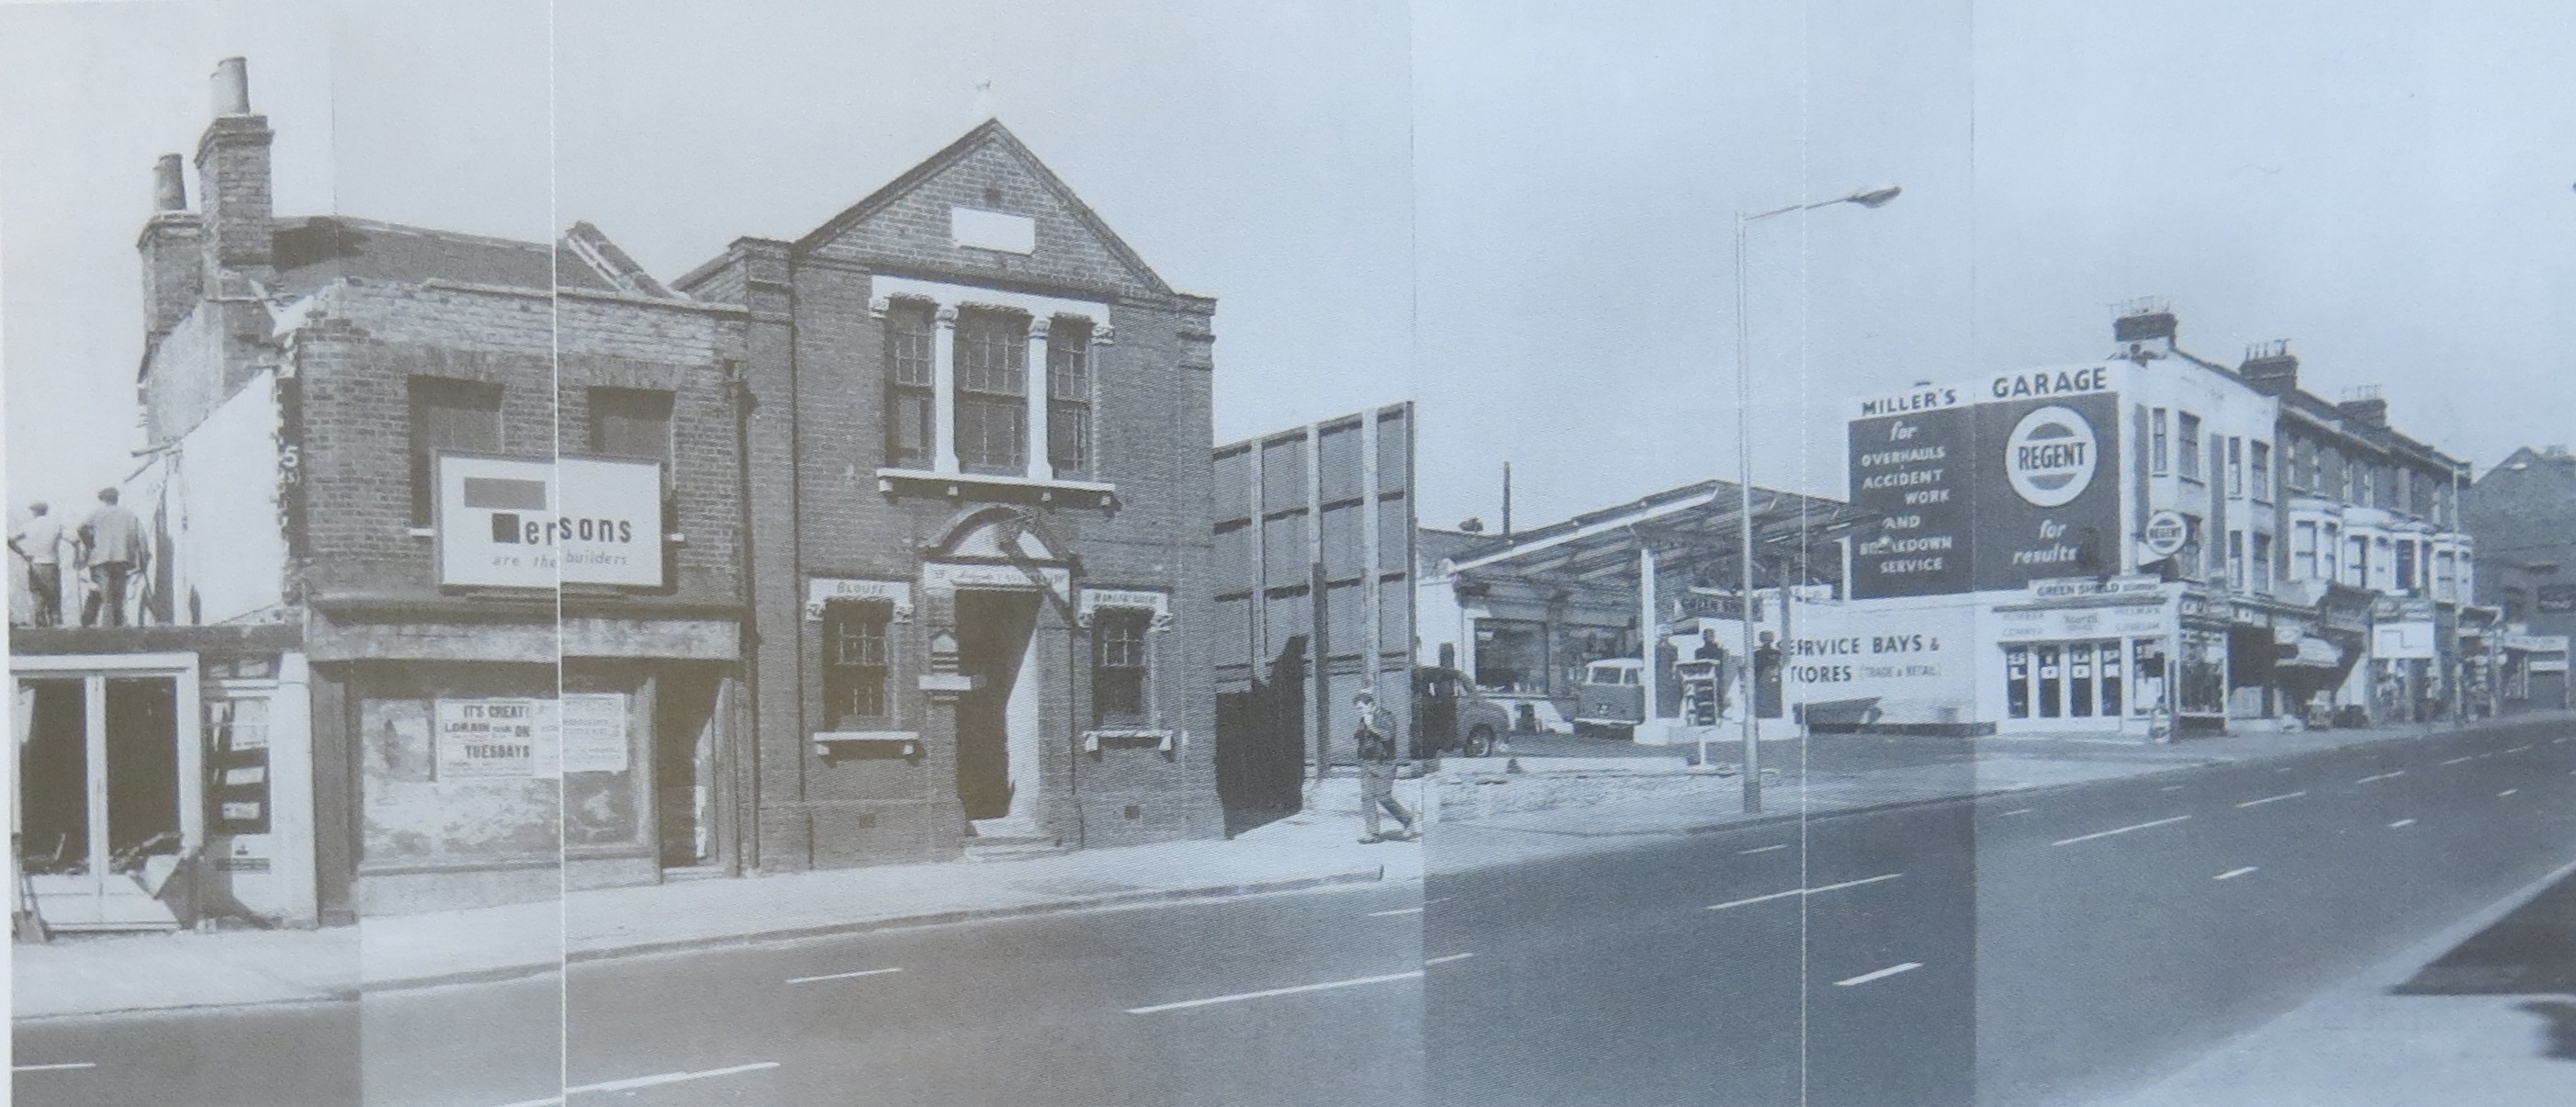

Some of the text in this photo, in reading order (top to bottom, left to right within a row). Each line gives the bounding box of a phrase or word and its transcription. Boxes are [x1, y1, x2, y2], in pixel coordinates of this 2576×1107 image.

[1862, 367, 2107, 416] MILLER'S GARAGE
[1889, 421, 1918, 442] for
[1861, 446, 1946, 467] OVERHAULS
[2018, 441, 2087, 470] REGENT
[1862, 469, 1943, 490] ACCIDENT
[1905, 489, 1950, 504] WORK
[1881, 514, 1921, 529] AND
[2039, 518, 2066, 540] for
[566, 550, 628, 566] builders
[1879, 557, 1943, 574] SERVICE
[1872, 634, 1922, 654] BAYS
[1929, 637, 1940, 651] &
[465, 744, 531, 759] TUESDAYS
